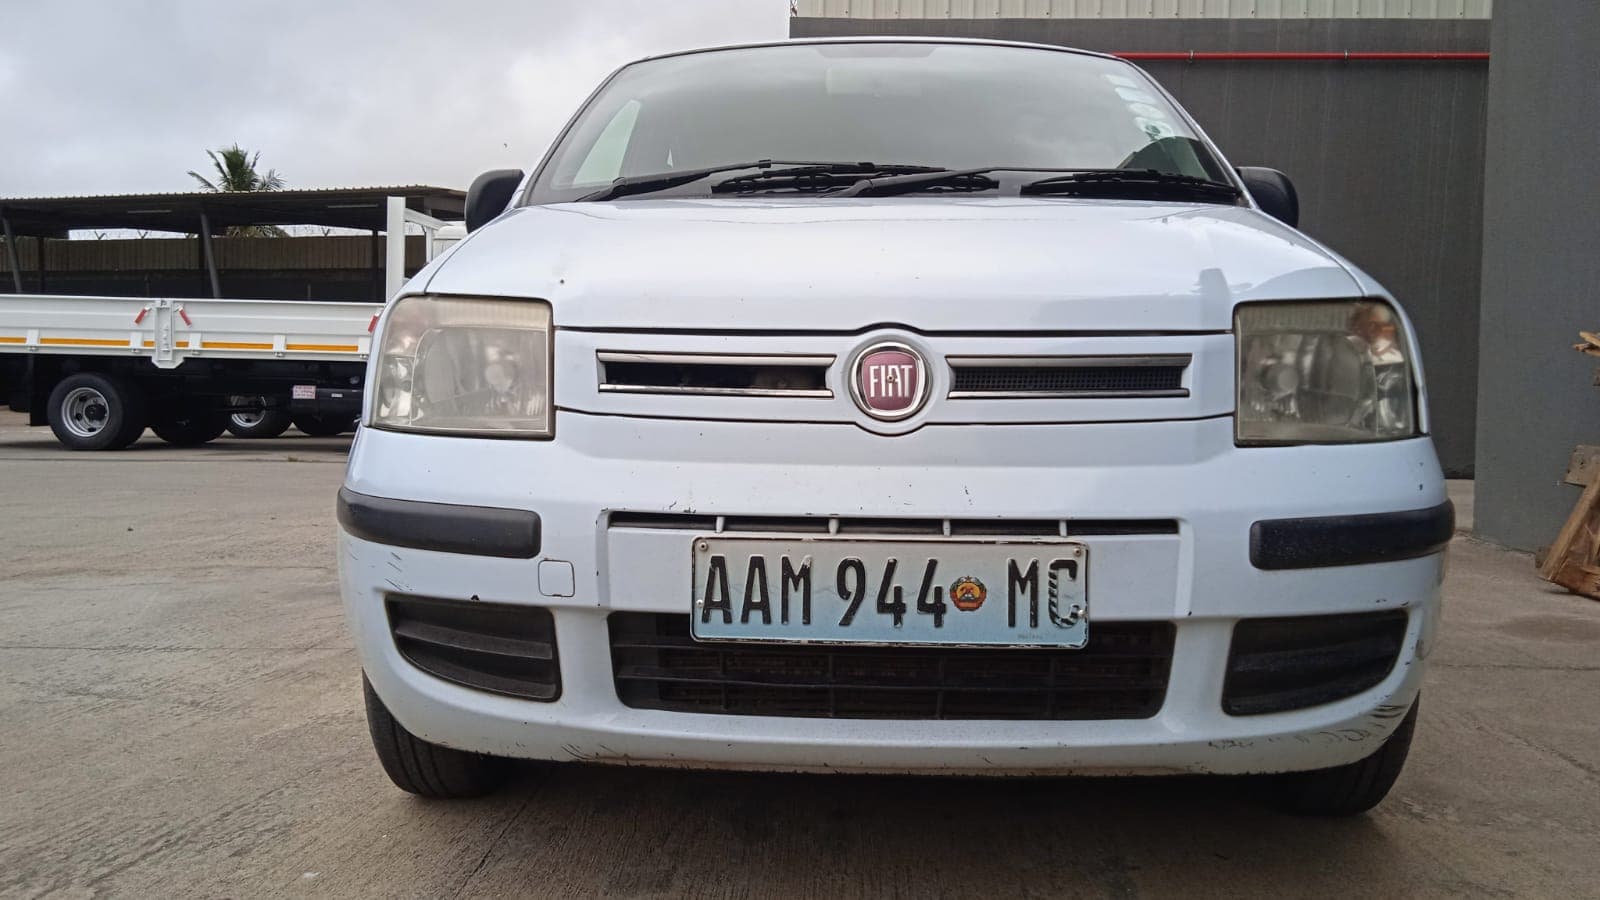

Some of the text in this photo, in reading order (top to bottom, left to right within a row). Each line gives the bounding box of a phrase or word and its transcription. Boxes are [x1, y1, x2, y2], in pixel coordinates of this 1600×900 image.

[869, 365, 913, 398] FIAT
[701, 555, 1079, 629] AAM 944 MC
